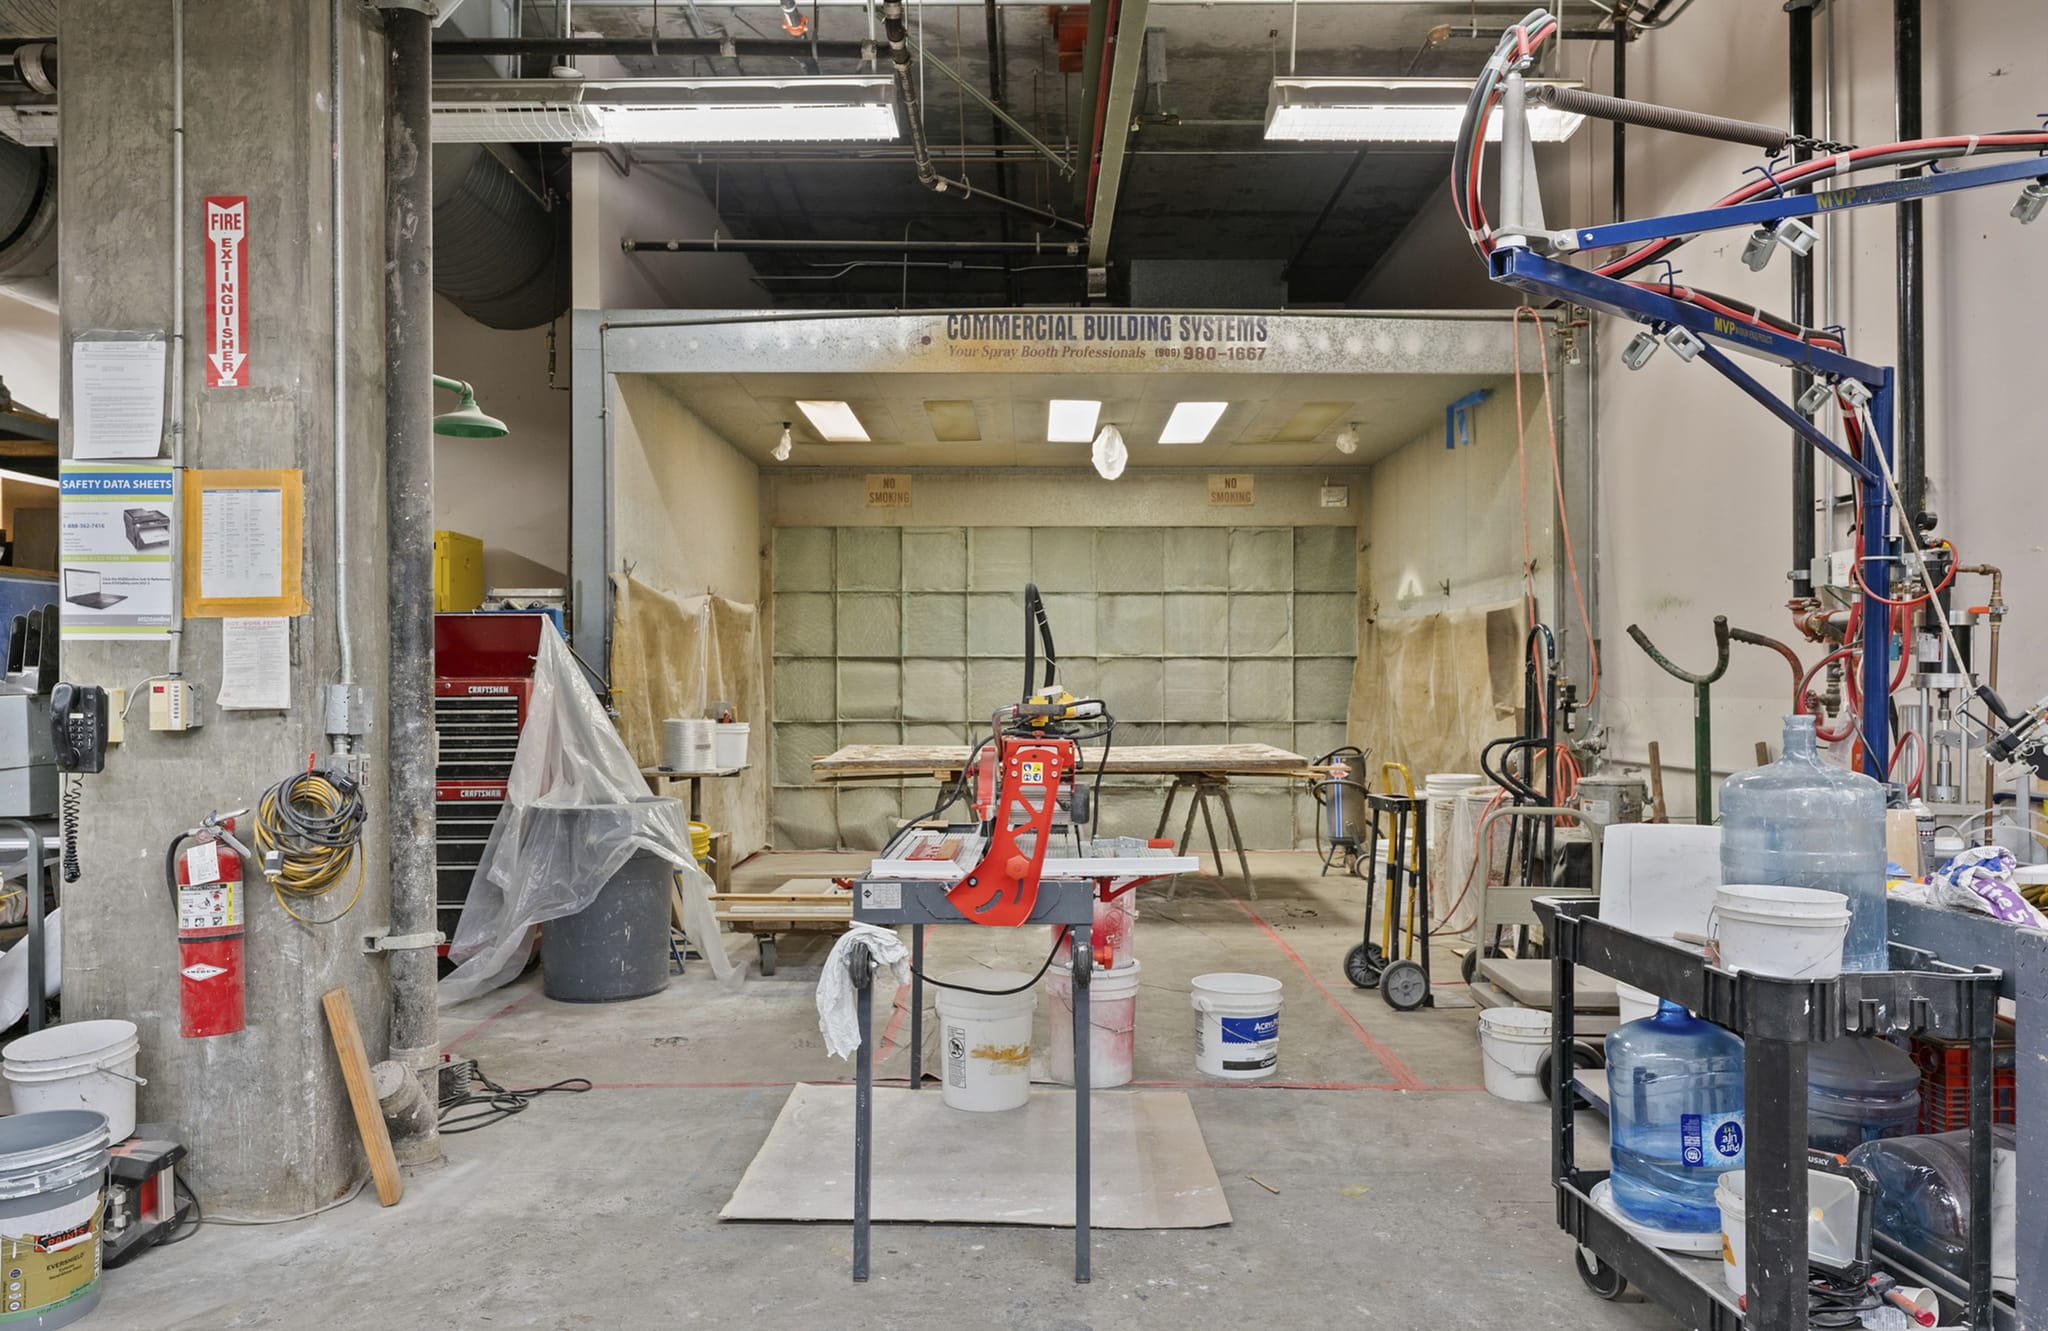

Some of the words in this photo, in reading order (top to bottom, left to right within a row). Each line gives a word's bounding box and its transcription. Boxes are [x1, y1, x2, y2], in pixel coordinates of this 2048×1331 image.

[1816, 188, 1857, 209] MVP
[211, 213, 242, 231] FIRE
[221, 237, 234, 373] EXTINGUISHER
[947, 314, 1077, 342] COMMERCIAL
[1083, 315, 1172, 342] BUILDING
[1179, 315, 1268, 342] SYSTEMS
[1714, 316, 1736, 336] MVP
[948, 345, 977, 358] Your
[981, 345, 1018, 360] Spray
[1021, 345, 1059, 359] Booth
[1062, 345, 1147, 360] Professionals
[62, 480, 101, 489] SAFETY
[103, 480, 131, 489] DATA
[133, 480, 172, 489] SHEETS
[883, 477, 896, 489] NO
[1224, 477, 1238, 489] NO
[869, 491, 911, 504] SMOKING
[1210, 491, 1252, 503] SMOKING
[468, 686, 509, 694] CRAFTSMAN
[1722, 1132, 1738, 1144] Life
[1720, 1142, 1740, 1153] Pure
[1807, 1156, 1829, 1166] USKY
[46, 1253, 85, 1271] EVERSHIELD
